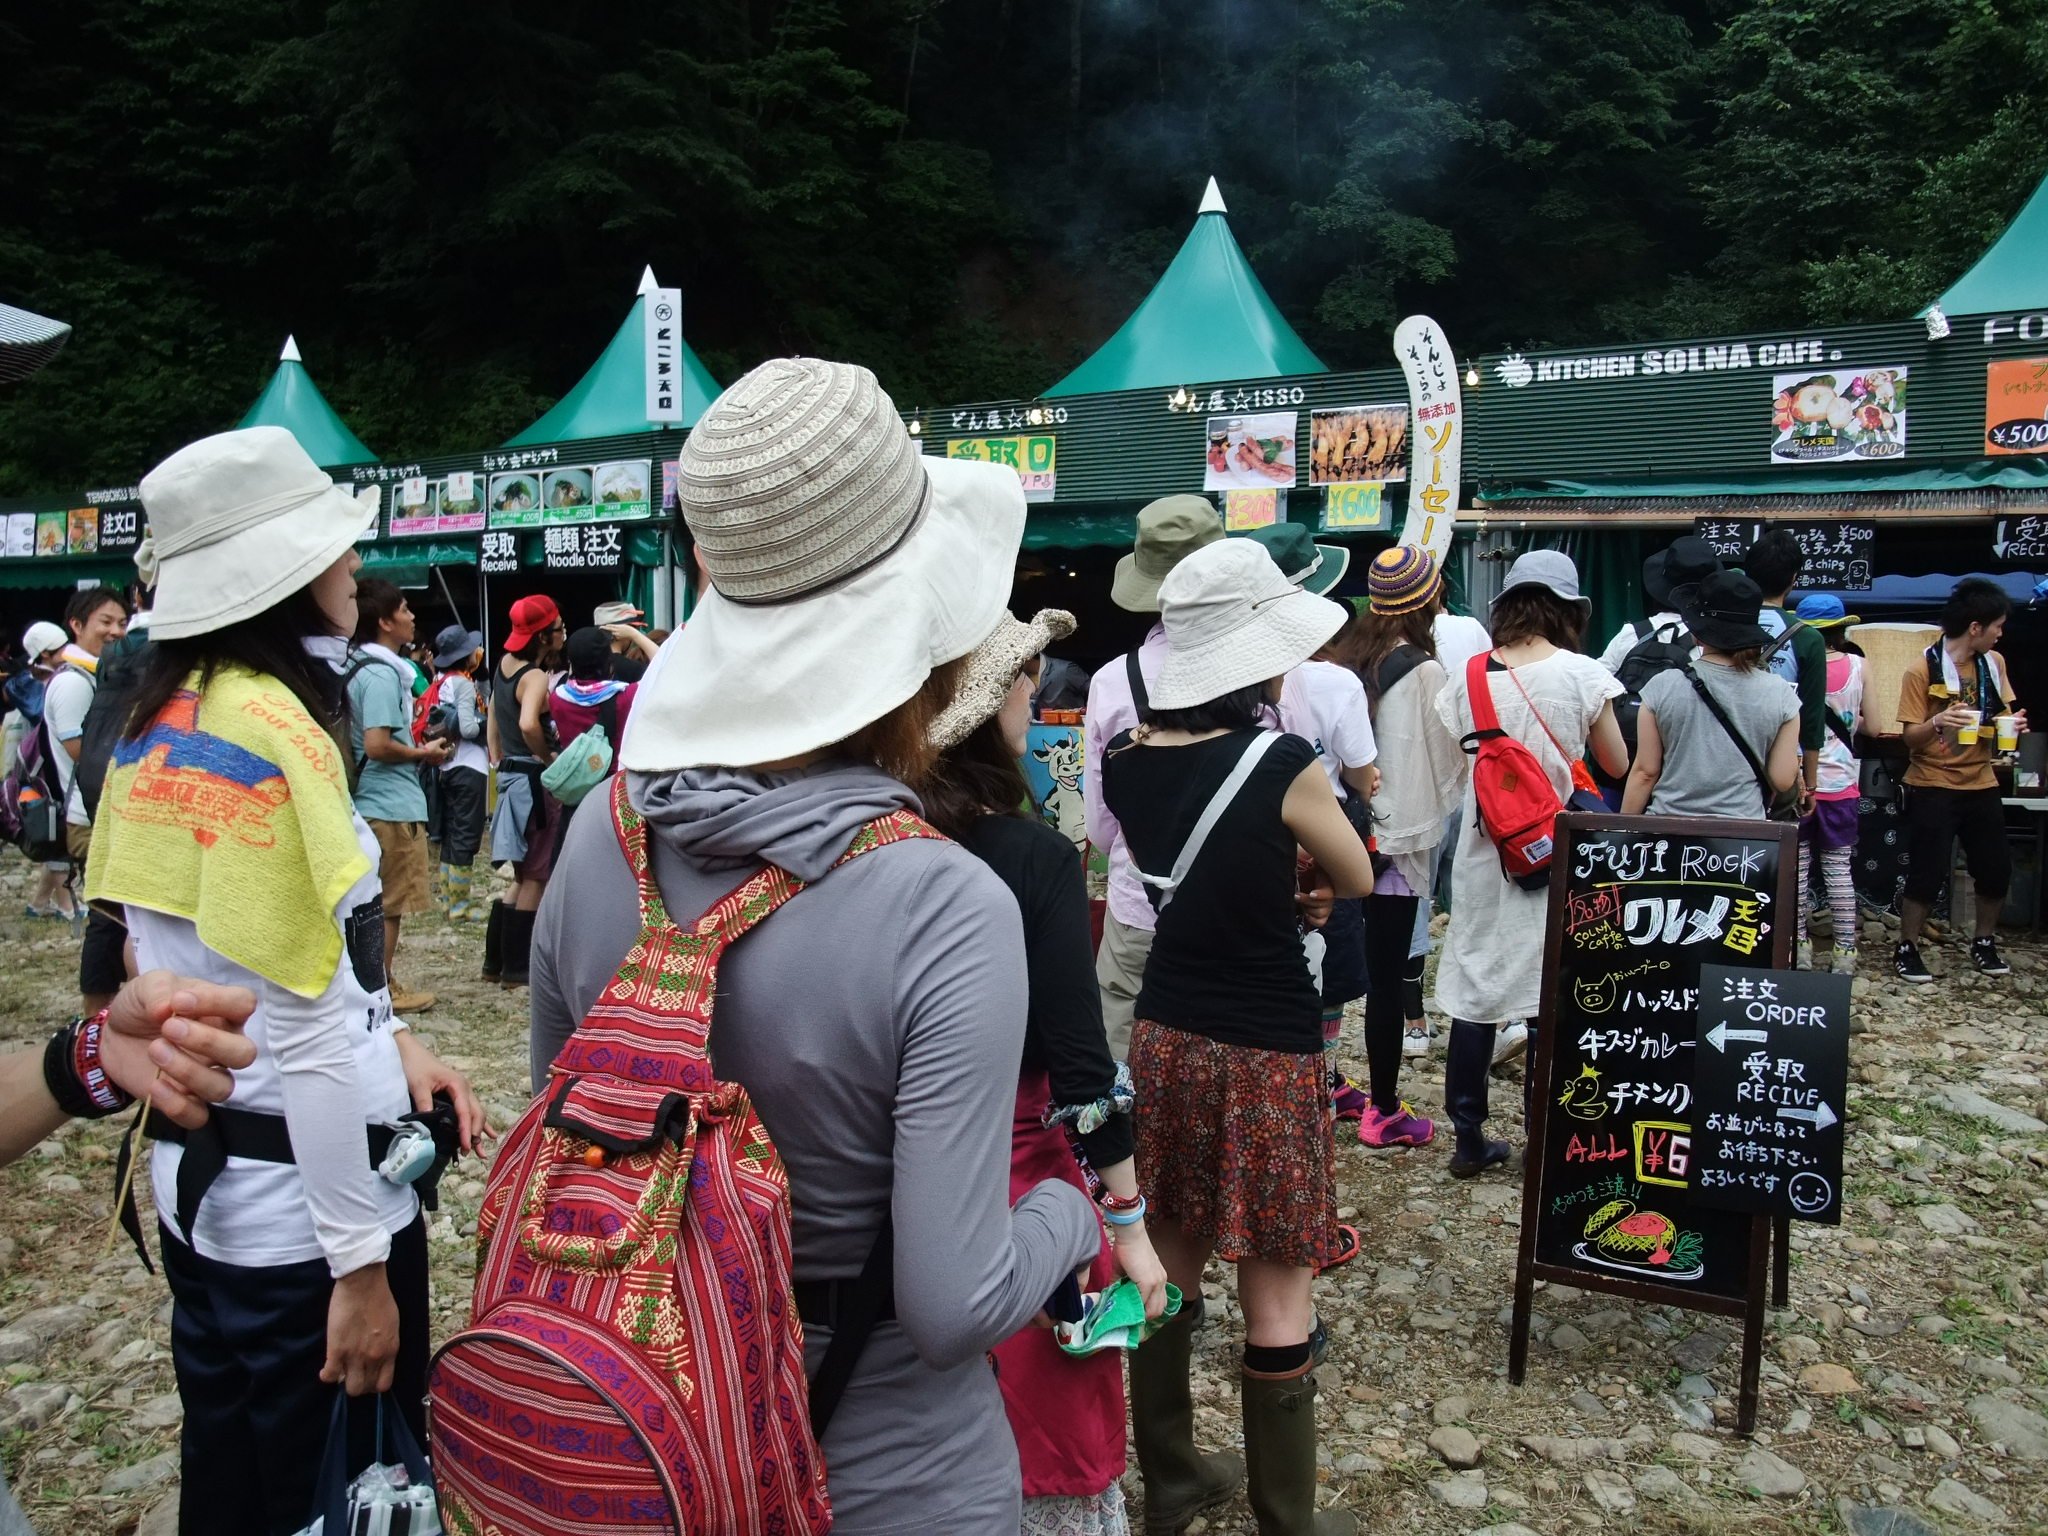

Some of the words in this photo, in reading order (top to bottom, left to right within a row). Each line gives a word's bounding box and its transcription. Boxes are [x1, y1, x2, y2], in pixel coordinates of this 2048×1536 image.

[1537, 355, 1635, 382] KITCHEN
[1641, 343, 1752, 376] SOLNA
[1758, 340, 1824, 367] CAFE
[1417, 402, 1457, 423] 無添加
[1330, 488, 1378, 521] ¥600
[103, 512, 137, 534] 注文口
[1700, 522, 1741, 539] 注文
[1839, 525, 1873, 541] ¥500
[482, 532, 516, 558] 受取
[583, 525, 622, 552] 注文
[1813, 541, 1853, 555] チップス
[481, 557, 518, 572] Receive
[547, 554, 585, 568] Noodle
[588, 552, 620, 565] Order
[1575, 840, 1669, 880] FUJI
[1680, 845, 1767, 886] ROCK
[1722, 977, 1779, 1001] 注文
[1745, 1001, 1827, 1029] ORDER
[1577, 1026, 1697, 1061] 牛スジカレー
[1742, 1050, 1806, 1084] 受取
[1737, 1081, 1820, 1106] RECIVE
[1705, 1112, 1807, 1139] お並びになって
[1565, 1132, 1629, 1163] ALL
[1718, 1139, 1818, 1167] お待ち下さい
[1700, 1167, 1781, 1194] よろしくです
